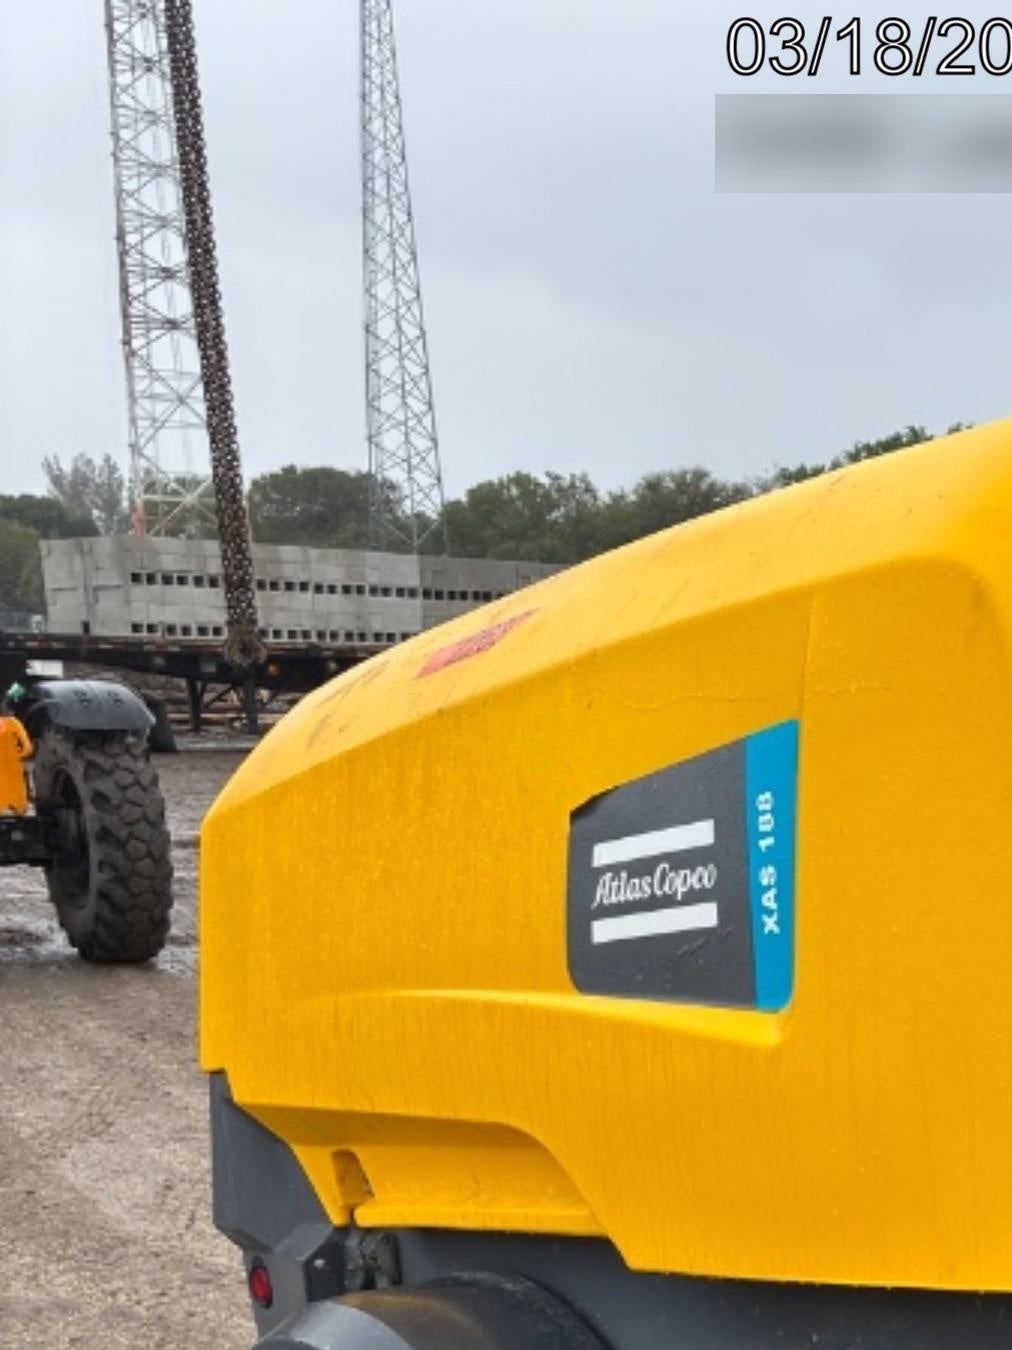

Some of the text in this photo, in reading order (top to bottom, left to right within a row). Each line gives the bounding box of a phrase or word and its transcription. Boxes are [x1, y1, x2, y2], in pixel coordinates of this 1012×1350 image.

[592, 863, 717, 909] Atlas Copco
[757, 792, 780, 934] XAS 188
